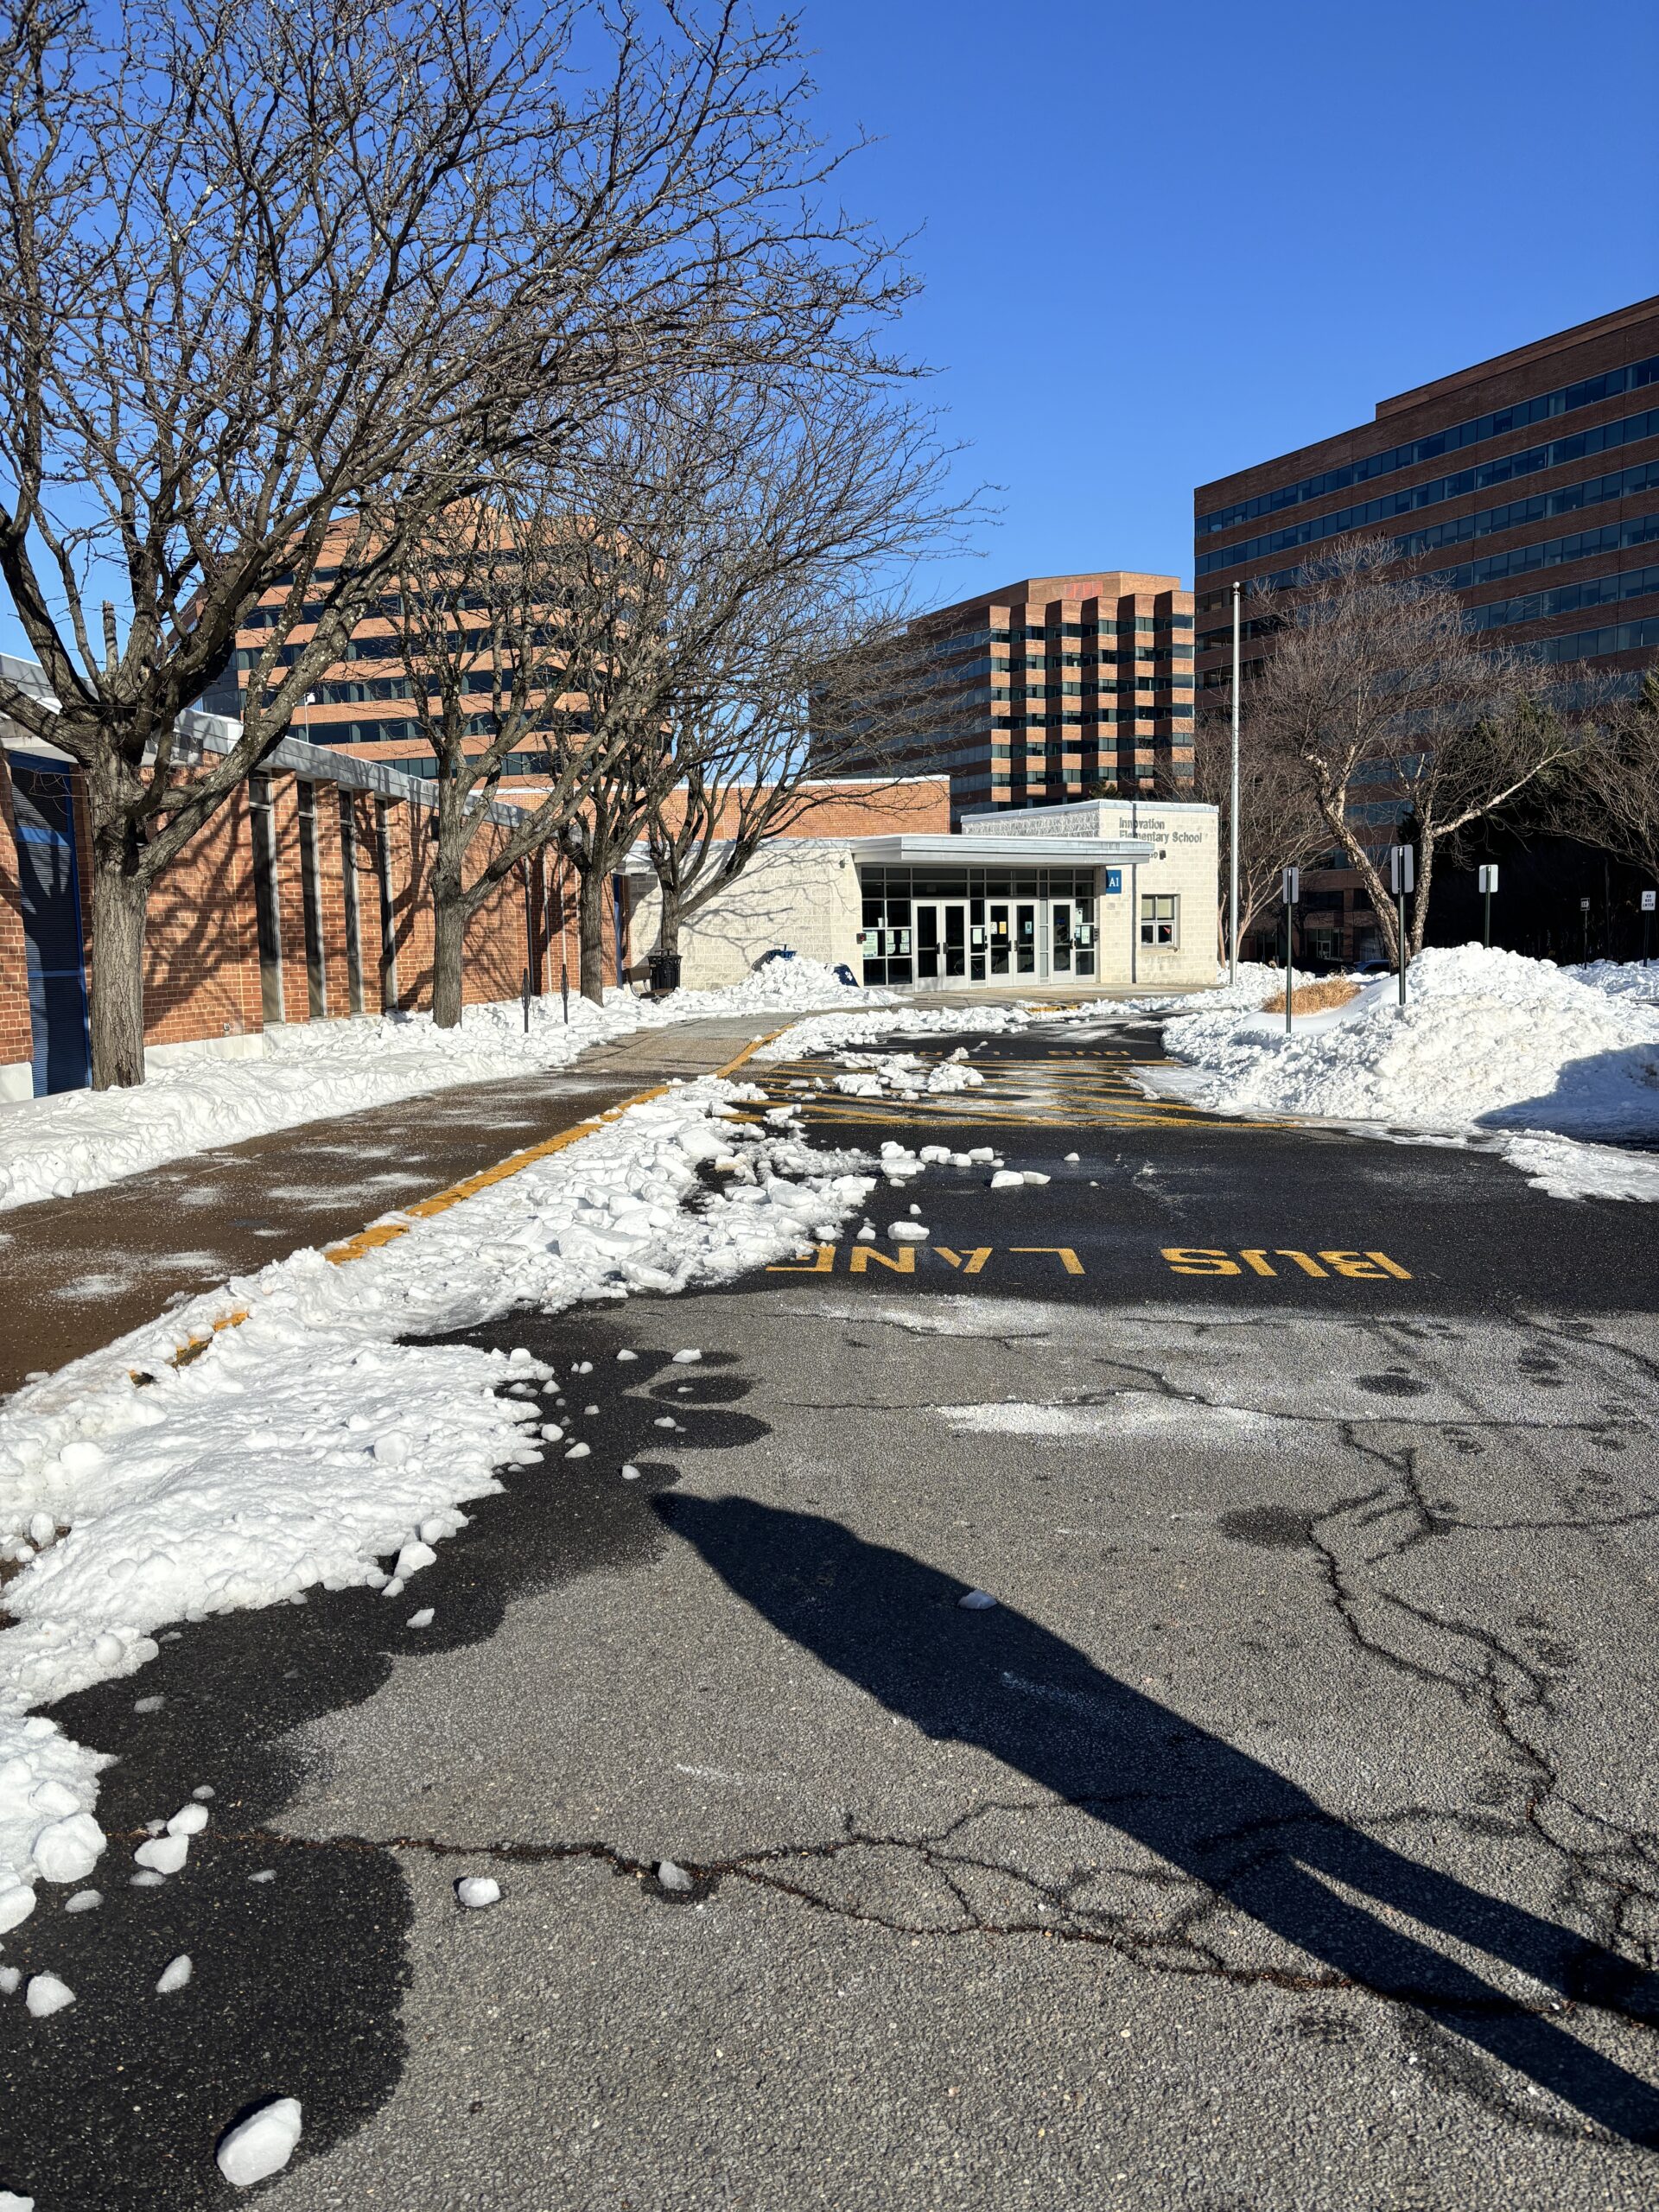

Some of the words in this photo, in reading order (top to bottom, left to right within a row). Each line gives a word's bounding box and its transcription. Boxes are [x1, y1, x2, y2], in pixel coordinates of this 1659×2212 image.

[1119, 817, 1165, 830] Innovation
[1119, 830, 1169, 844] Elementary
[1172, 831, 1202, 842] School
[1109, 877, 1119, 887] A1
[766, 1246, 1085, 1274] LANE
[1160, 1248, 1413, 1279] BUS
